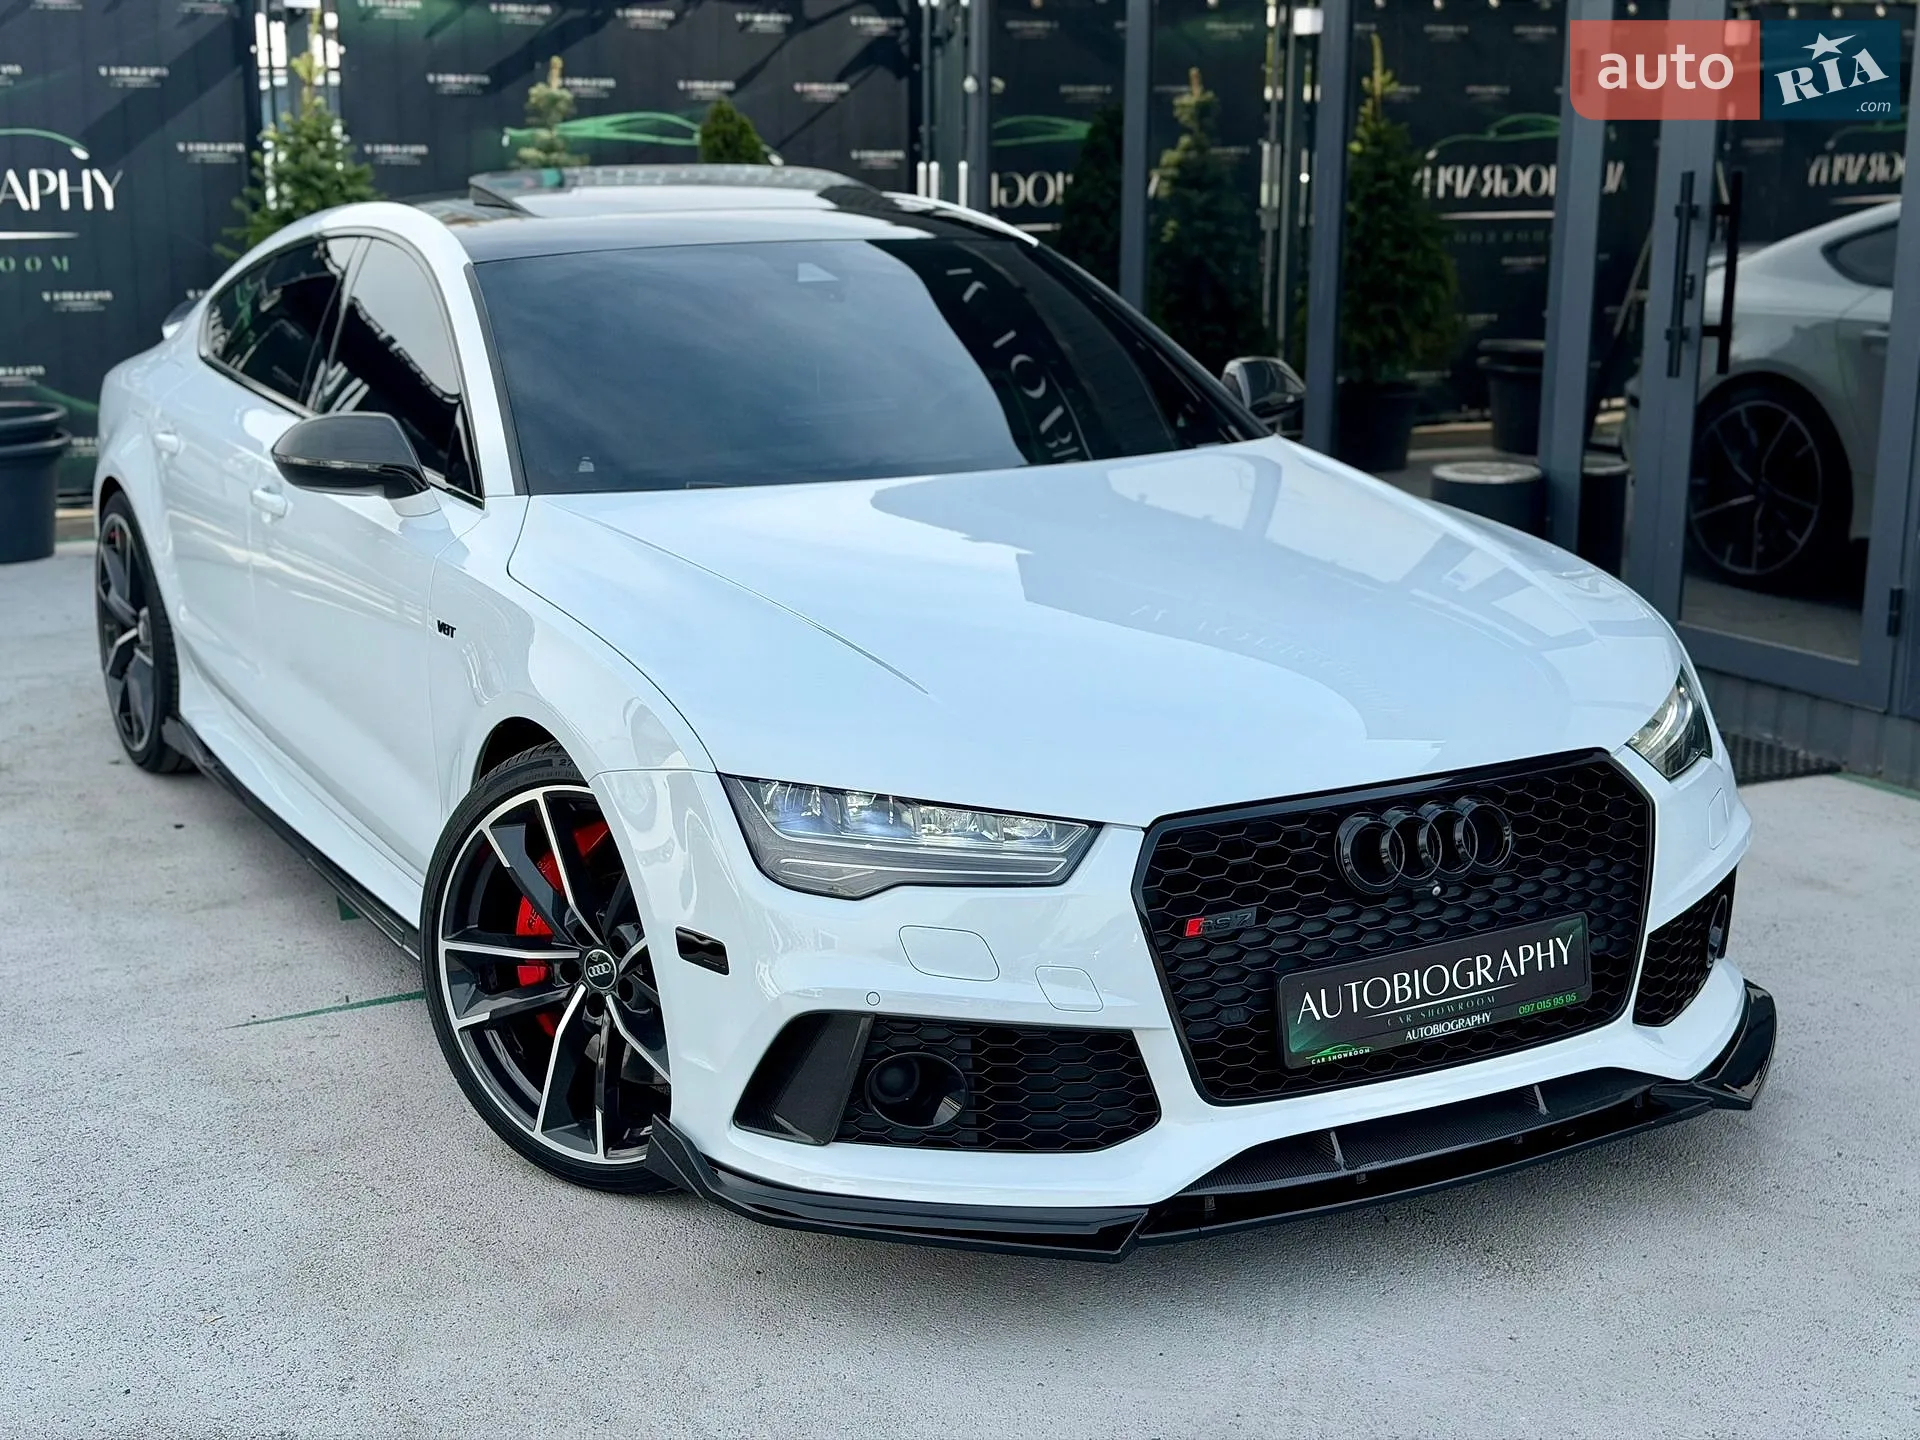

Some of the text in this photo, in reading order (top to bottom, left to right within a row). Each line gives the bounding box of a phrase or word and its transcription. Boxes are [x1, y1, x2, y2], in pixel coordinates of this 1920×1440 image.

[1297, 934, 1573, 1025] AUTOBIOGRAPHY
[1387, 995, 1496, 1027] CAR SHOWROOM
[1518, 992, 1577, 1016] 097 015 95 95
[1405, 1012, 1492, 1041] AUTOBIOGRAPHY
[1311, 1048, 1371, 1065] CAR SHOWROOM
